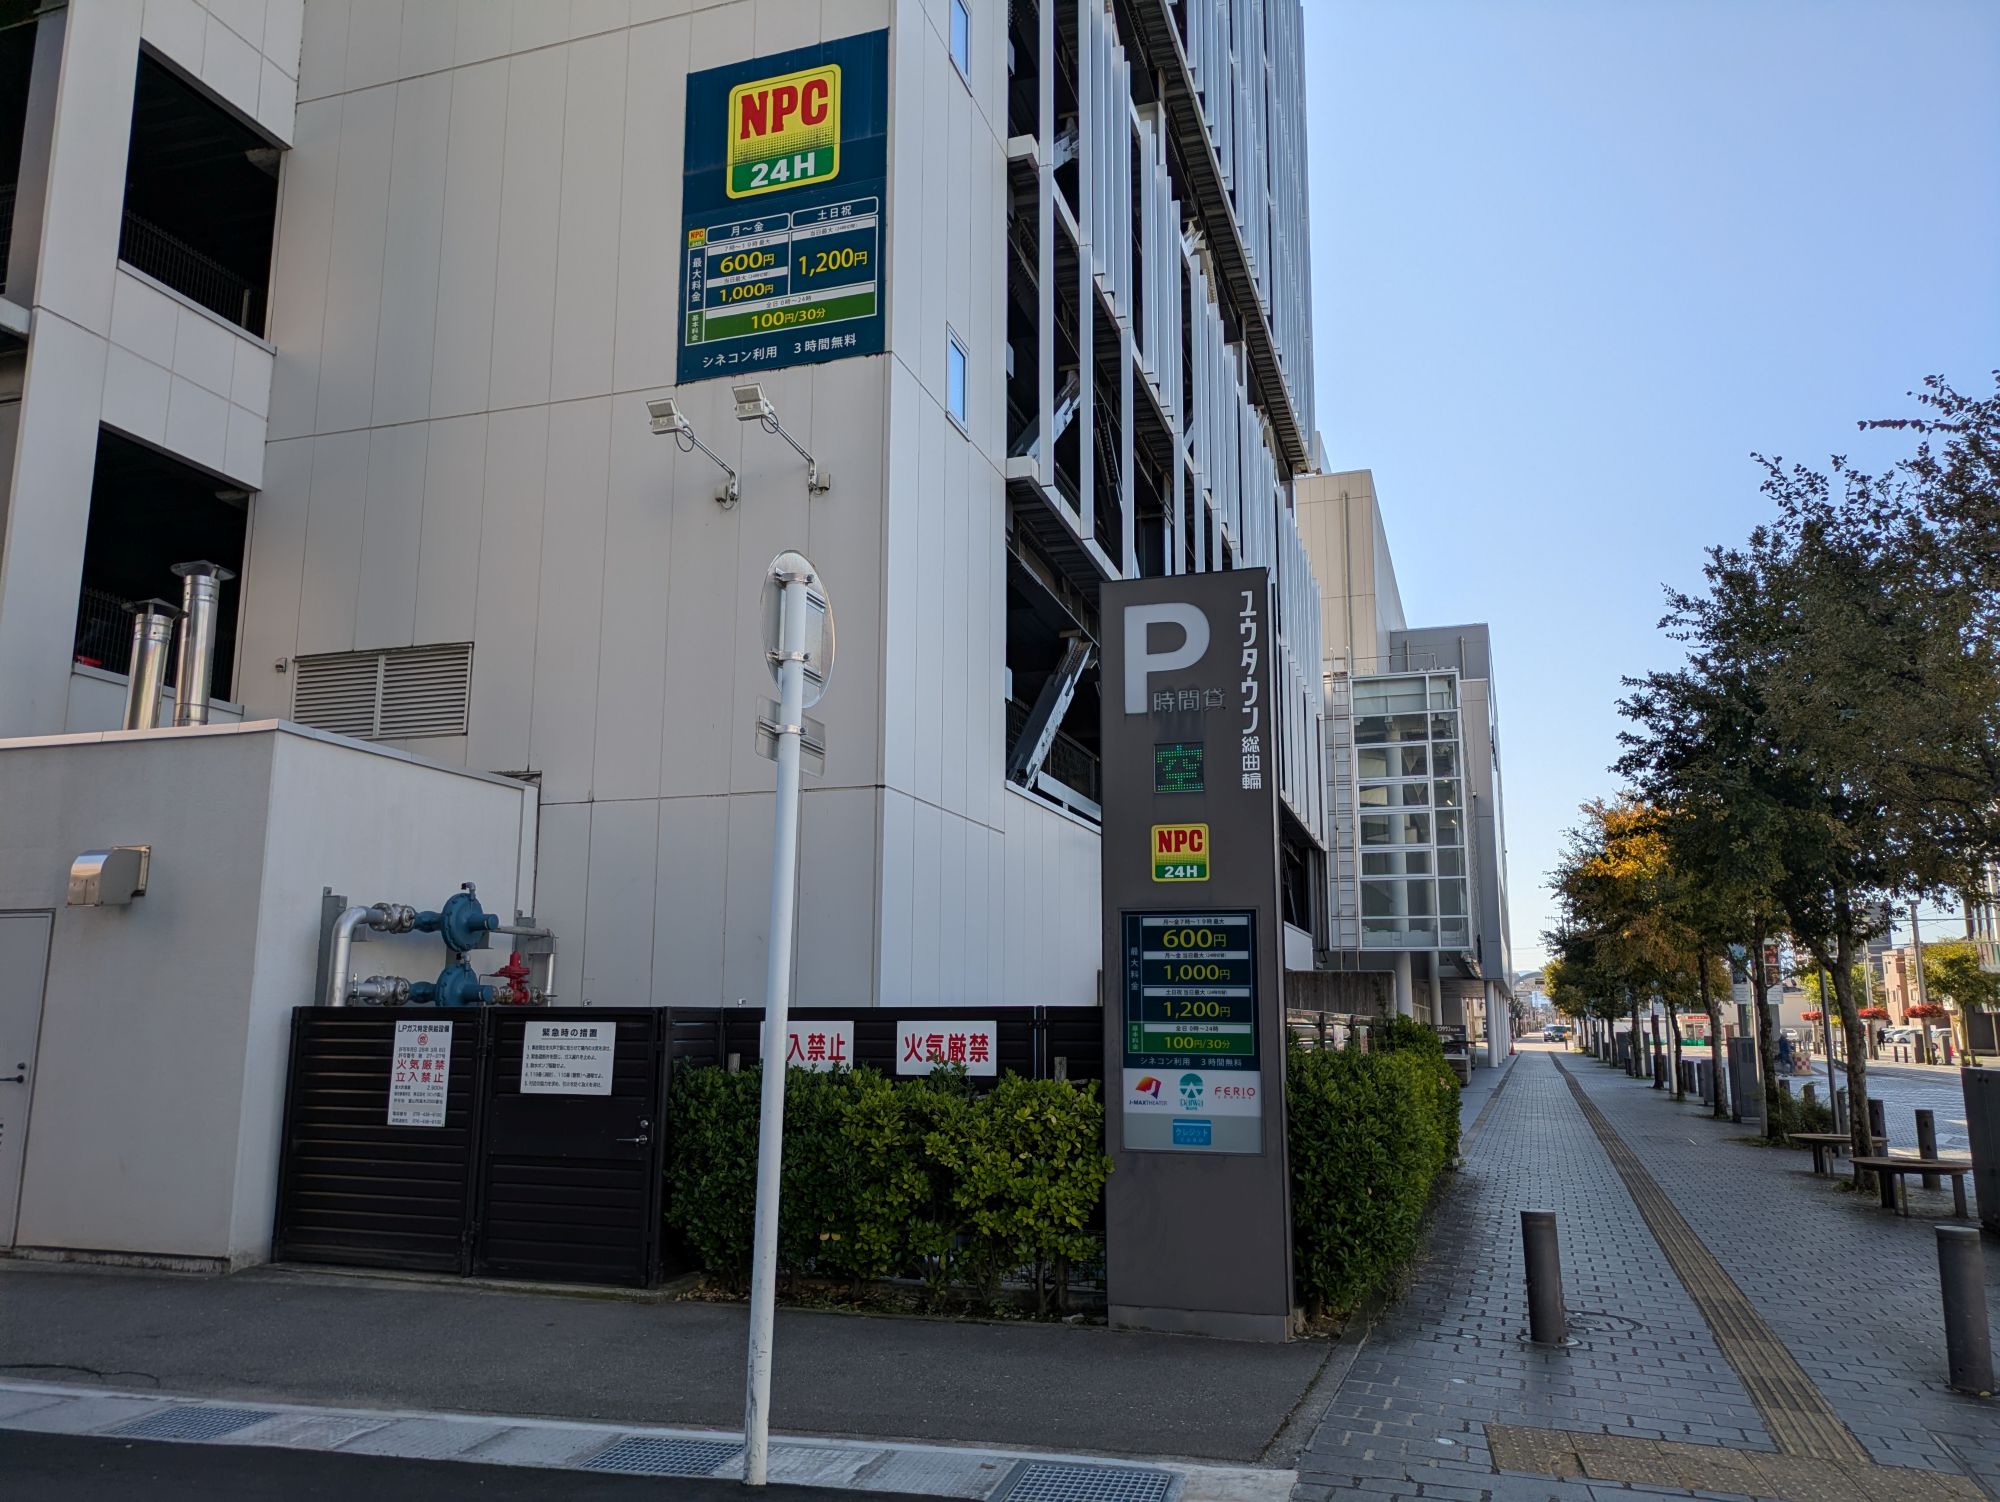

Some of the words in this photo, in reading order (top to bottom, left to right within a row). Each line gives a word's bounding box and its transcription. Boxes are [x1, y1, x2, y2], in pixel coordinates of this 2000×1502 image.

[740, 79, 829, 140] NPC
[750, 152, 815, 188] 24H
[817, 205, 852, 221] 土日祝
[690, 230, 705, 239] NPC
[720, 251, 775, 274] 600円
[799, 248, 868, 278] 1,200円
[692, 257, 702, 302] 最大料金
[719, 282, 774, 304] 1,000円
[751, 307, 826, 330] 100円/30分
[702, 346, 778, 369] シネコン利用
[1124, 602, 1211, 715] P
[1153, 687, 1227, 713] 時間貸
[1157, 744, 1204, 792] 空
[1158, 829, 1204, 853] NPC
[1164, 866, 1198, 878] 24H
[1163, 928, 1227, 948] 600円
[1130, 946, 1139, 991] 最大料金
[1163, 964, 1230, 982] 1,000円
[1163, 1001, 1230, 1019] 1,200円
[542, 1027, 598, 1038] 緊急時の措置
[1164, 1036, 1231, 1049] 100円/30分
[787, 1033, 846, 1061] 入禁止
[903, 1033, 989, 1063] 火気厳禁
[396, 1059, 446, 1070] 火気厳禁
[1140, 1057, 1190, 1066] シネコン利用
[395, 1071, 444, 1083] 立入禁止
[1214, 1086, 1256, 1097] FERIO
